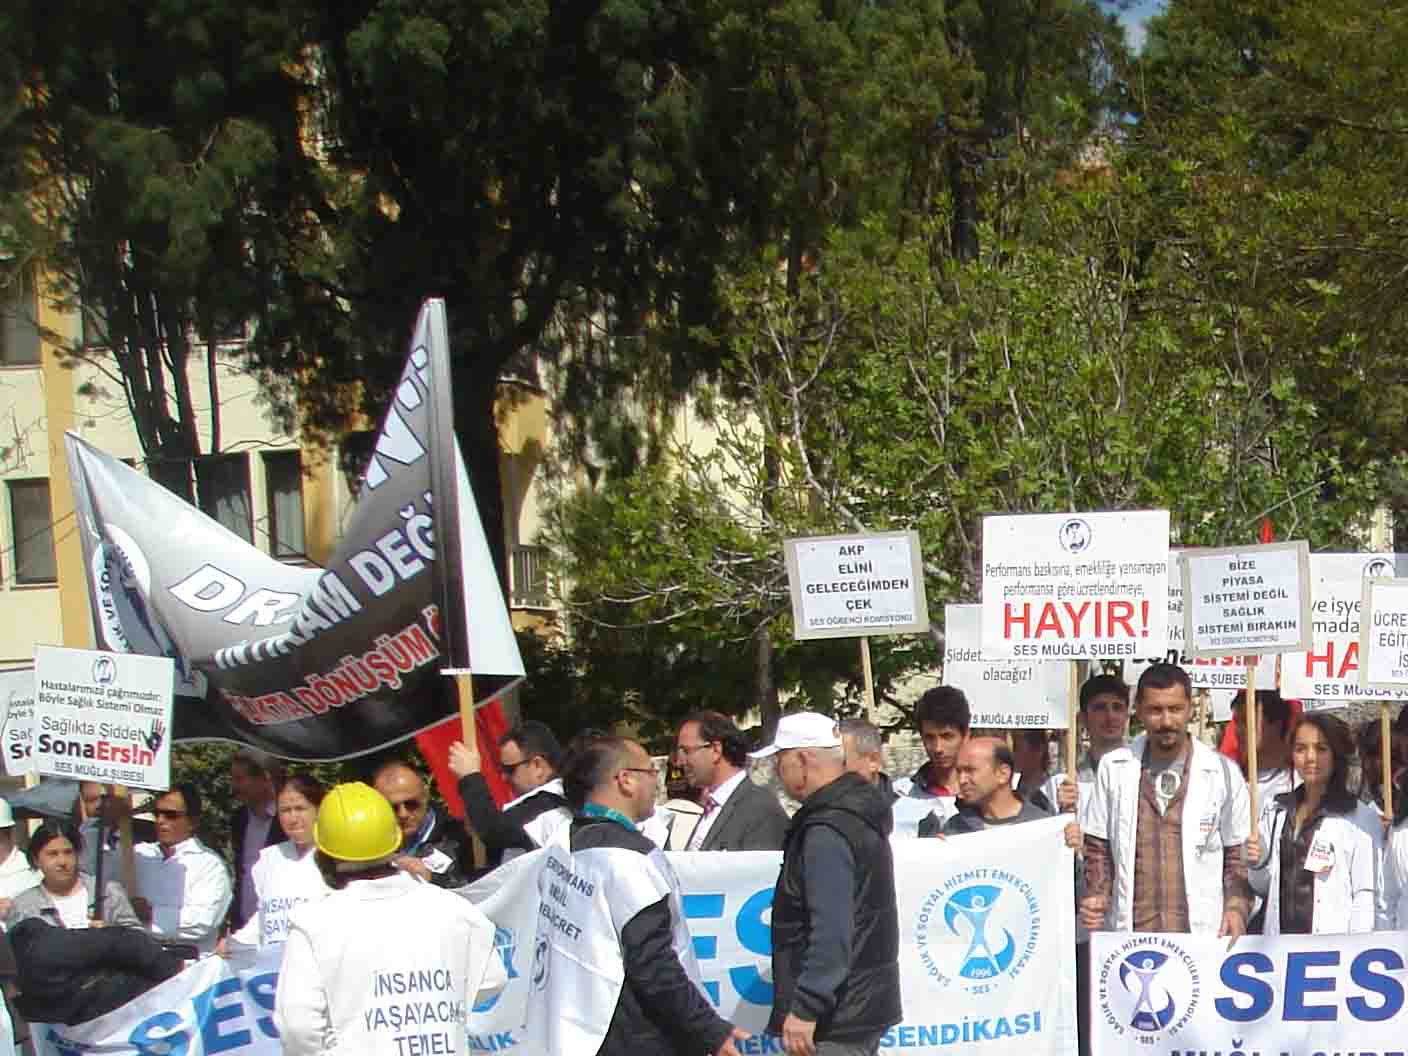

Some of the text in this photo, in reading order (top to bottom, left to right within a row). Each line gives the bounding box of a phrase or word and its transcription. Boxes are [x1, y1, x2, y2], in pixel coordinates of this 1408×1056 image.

[839, 545, 864, 556] AKP
[1003, 600, 1150, 639] HAYIR!
[1013, 644, 1038, 656] SES
[1042, 642, 1086, 656] MUĞLA
[1092, 641, 1136, 658] ŞUBESİ
[1211, 672, 1247, 686] ŞUBES
[1314, 684, 1340, 696] SES
[1214, 947, 1406, 1022] SES
[881, 1010, 1041, 1047] SENDİKASI
